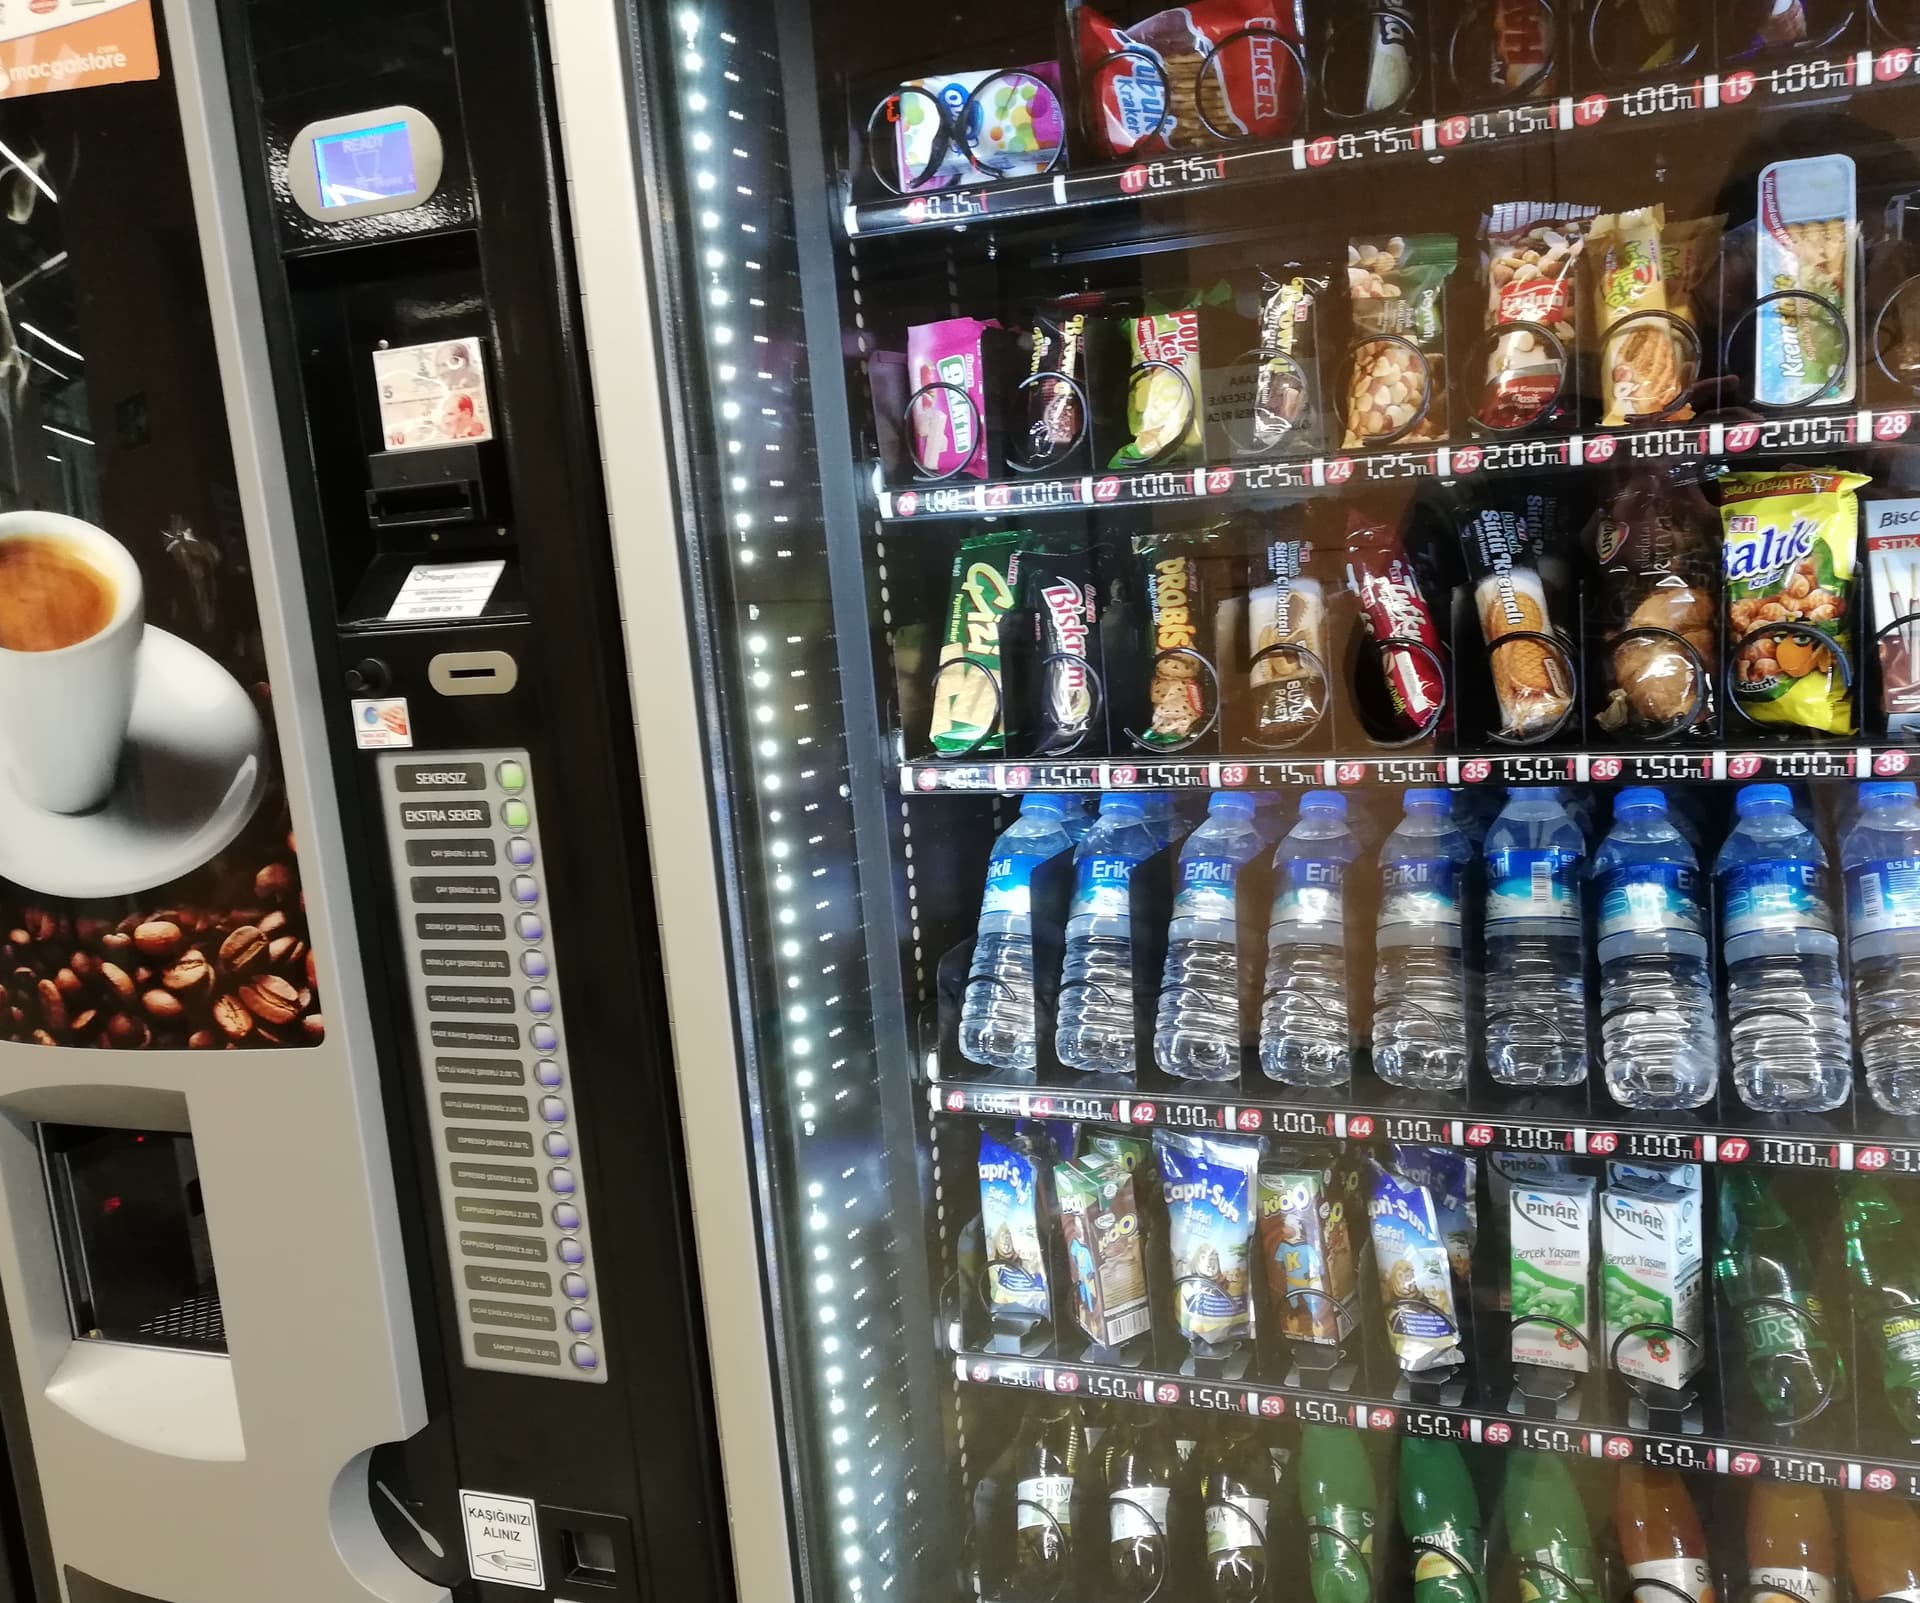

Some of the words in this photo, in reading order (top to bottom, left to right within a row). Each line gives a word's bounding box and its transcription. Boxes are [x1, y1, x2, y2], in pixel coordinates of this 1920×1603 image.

[1882, 53, 1908, 74] 16
[1726, 76, 1753, 97] 15
[1116, 78, 1141, 136] Kraker
[1581, 101, 1606, 120] 14
[1444, 121, 1467, 140] 13
[1312, 142, 1333, 161] 12
[1123, 170, 1144, 188] 11
[1880, 414, 1907, 435] 28
[1730, 428, 1758, 447] 27
[1589, 440, 1614, 458] 26
[1455, 452, 1480, 469] 25
[1328, 462, 1351, 480] 24
[1097, 481, 1118, 498] 22
[1209, 473, 1231, 490] 23
[989, 490, 1009, 505] 21
[1481, 509, 1507, 554] Sütlü
[1464, 762, 1488, 779] 35
[1594, 760, 1619, 777] 36
[1732, 757, 1759, 774] 37
[1878, 755, 1905, 771] 38
[1009, 770, 1027, 786] 31
[1113, 769, 1133, 785] 32
[1223, 767, 1243, 783] 33
[1339, 765, 1360, 781] 34
[405, 810, 447, 823] EKSTRA
[1184, 861, 1233, 882] Erikli
[947, 1095, 964, 1109] 40
[1032, 1100, 1049, 1115] 41
[1134, 1107, 1154, 1122] 42
[1239, 1113, 1260, 1129] 43
[1349, 1120, 1372, 1136] 44
[1468, 1129, 1492, 1144] 45
[1591, 1136, 1616, 1152] 46
[1721, 1143, 1747, 1159] 47
[1859, 1151, 1886, 1168] 48
[1526, 1201, 1578, 1221] PINAR
[973, 1367, 989, 1381] 50
[1058, 1377, 1077, 1391] 51
[1158, 1388, 1178, 1403] 52
[1260, 1401, 1281, 1415] 53
[1371, 1413, 1393, 1428] 54
[1487, 1428, 1510, 1443] 55
[1607, 1441, 1631, 1458] 56
[1734, 1457, 1759, 1473] 57
[1867, 1474, 1893, 1491] 58
[468, 1507, 531, 1527] KAŞIĞINIZI
[483, 1527, 522, 1543] ALINIZ
